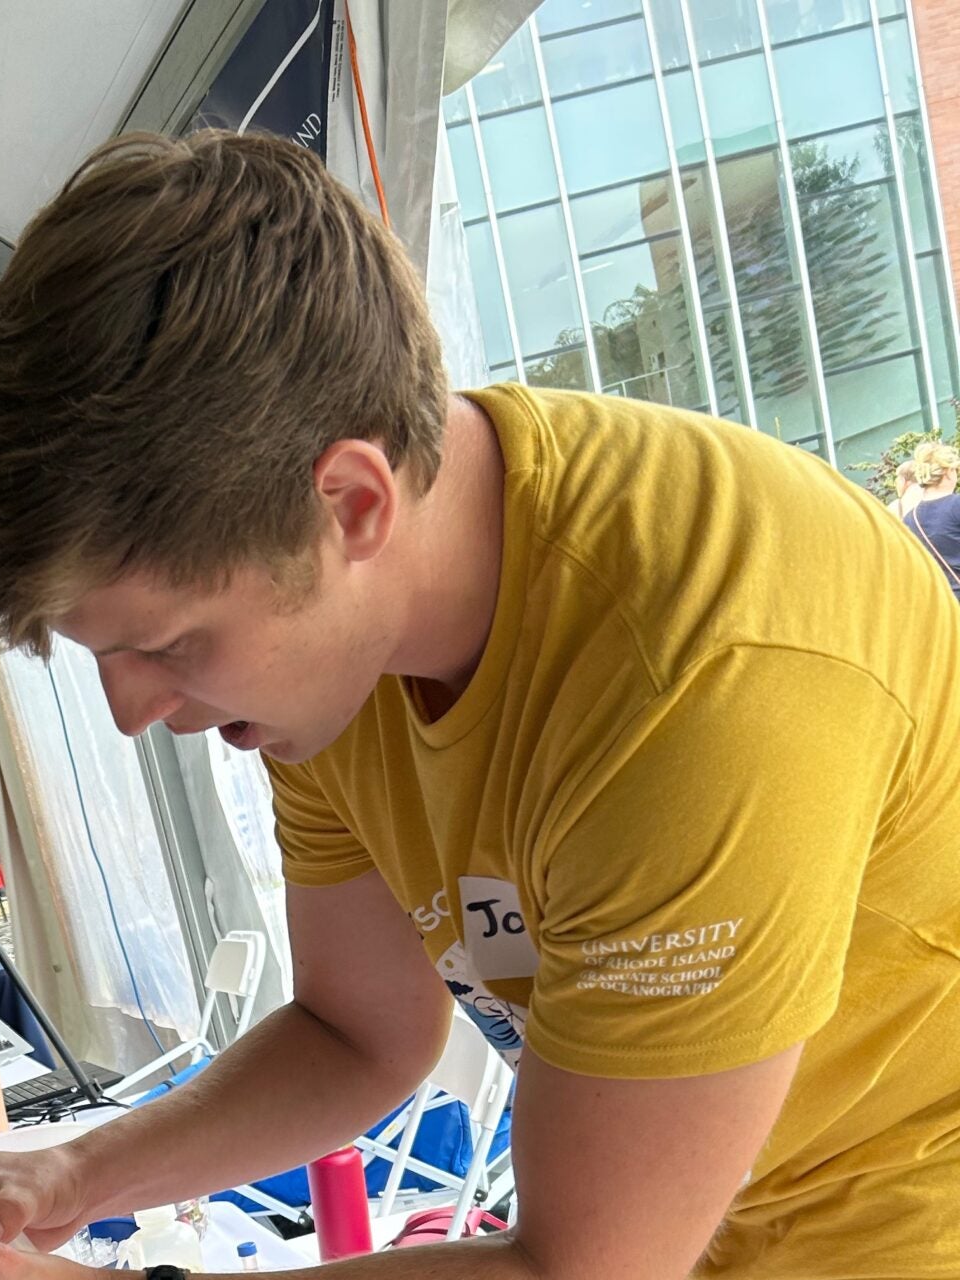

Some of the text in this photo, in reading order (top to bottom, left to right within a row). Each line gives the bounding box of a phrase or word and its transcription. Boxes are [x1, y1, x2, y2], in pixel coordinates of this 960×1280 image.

[581, 918, 743, 955] UNIVERSITY
[606, 955, 667, 970] RHODE
[659, 965, 724, 984] SCHOOL
